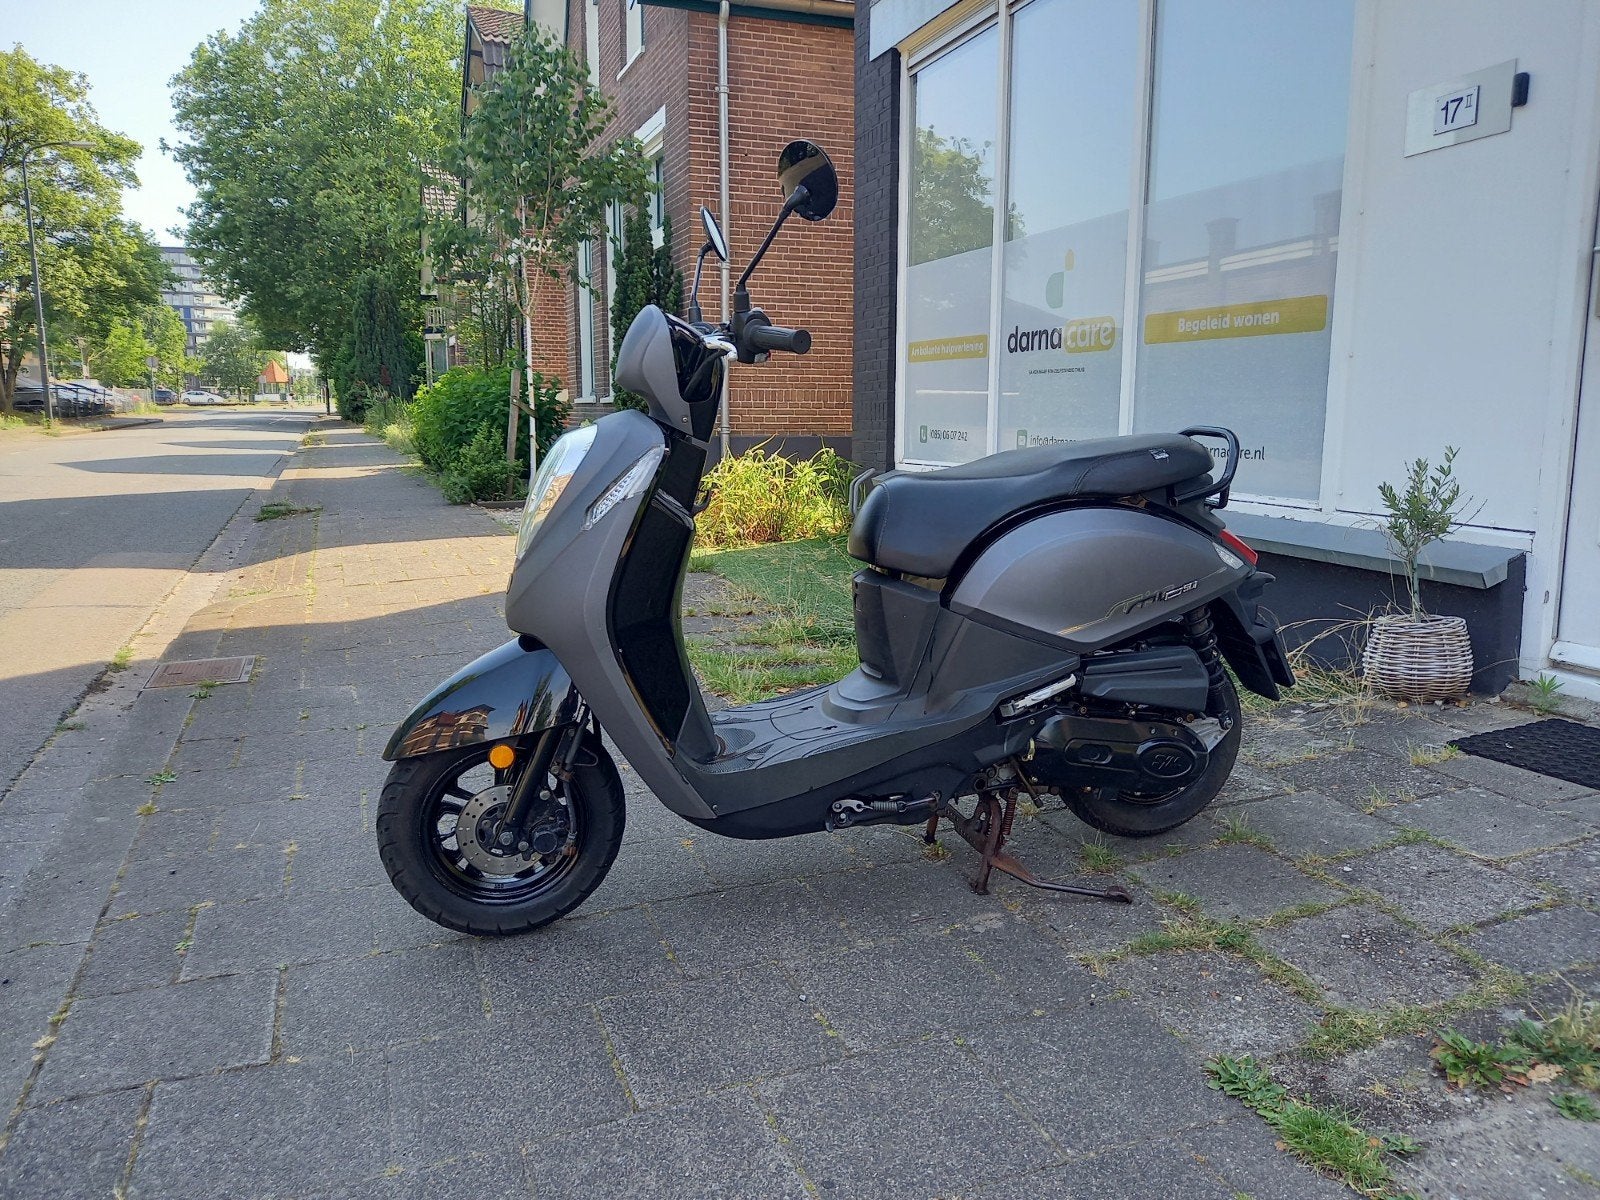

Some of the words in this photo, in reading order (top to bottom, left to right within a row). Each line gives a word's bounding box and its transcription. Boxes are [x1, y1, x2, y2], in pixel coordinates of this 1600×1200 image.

[1440, 96, 1463, 126] 17
[1177, 313, 1230, 335] Begeleid
[1233, 311, 1280, 328] wonen
